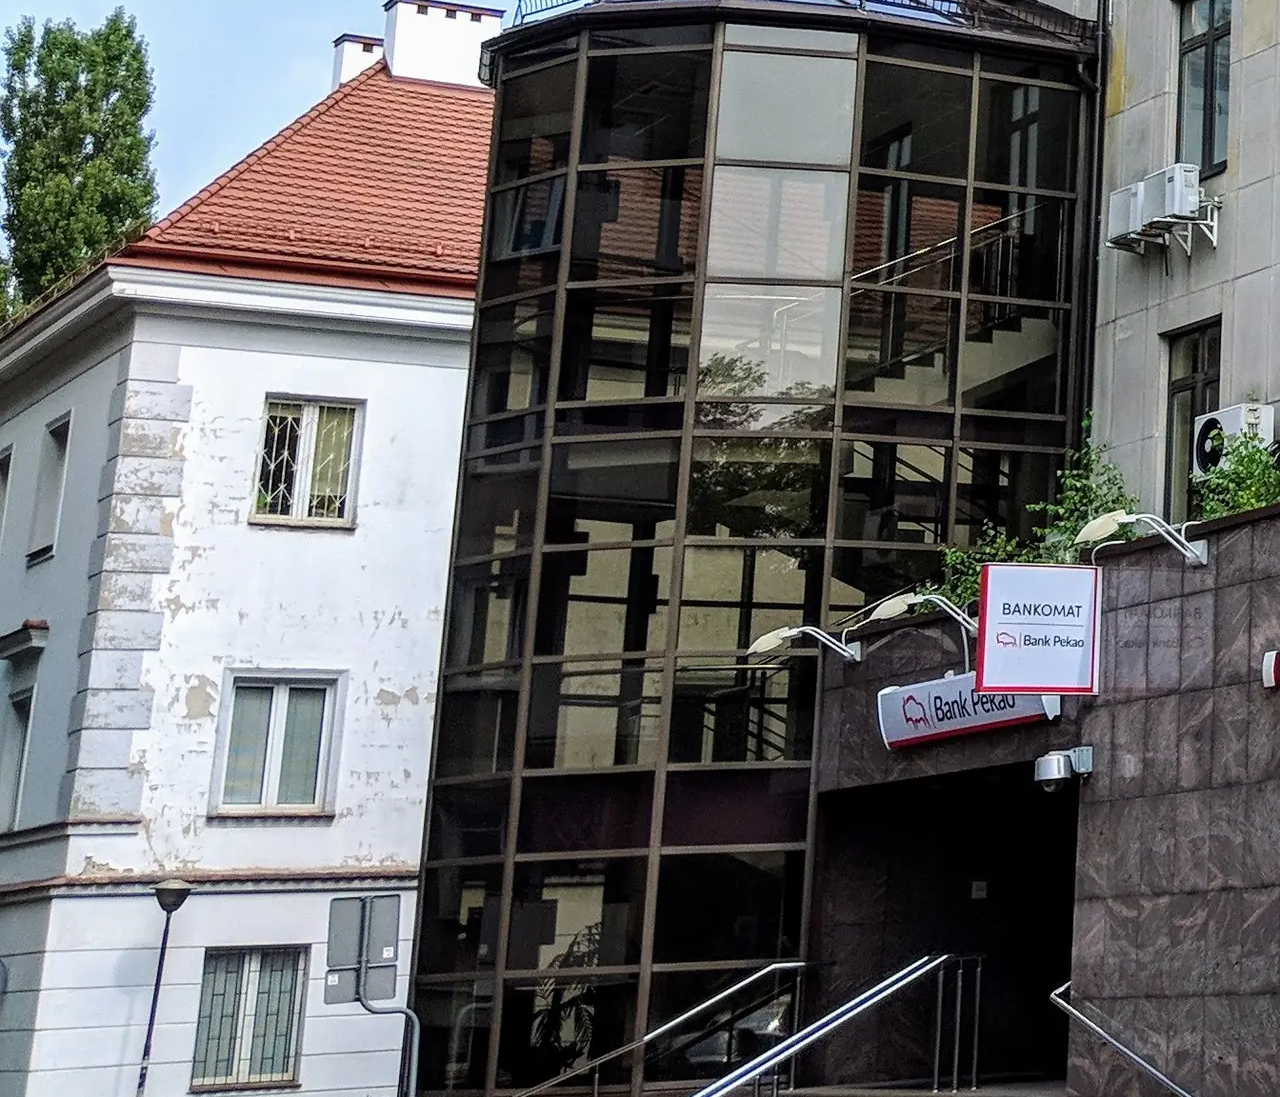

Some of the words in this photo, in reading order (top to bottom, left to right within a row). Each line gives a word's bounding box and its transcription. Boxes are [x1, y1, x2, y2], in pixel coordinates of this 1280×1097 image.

[1002, 603, 1082, 618] BANKOMAT
[1023, 634, 1051, 647] Bank
[1053, 635, 1085, 648] Pekao
[934, 691, 971, 722] Bank
[972, 693, 1016, 716] Pekao
